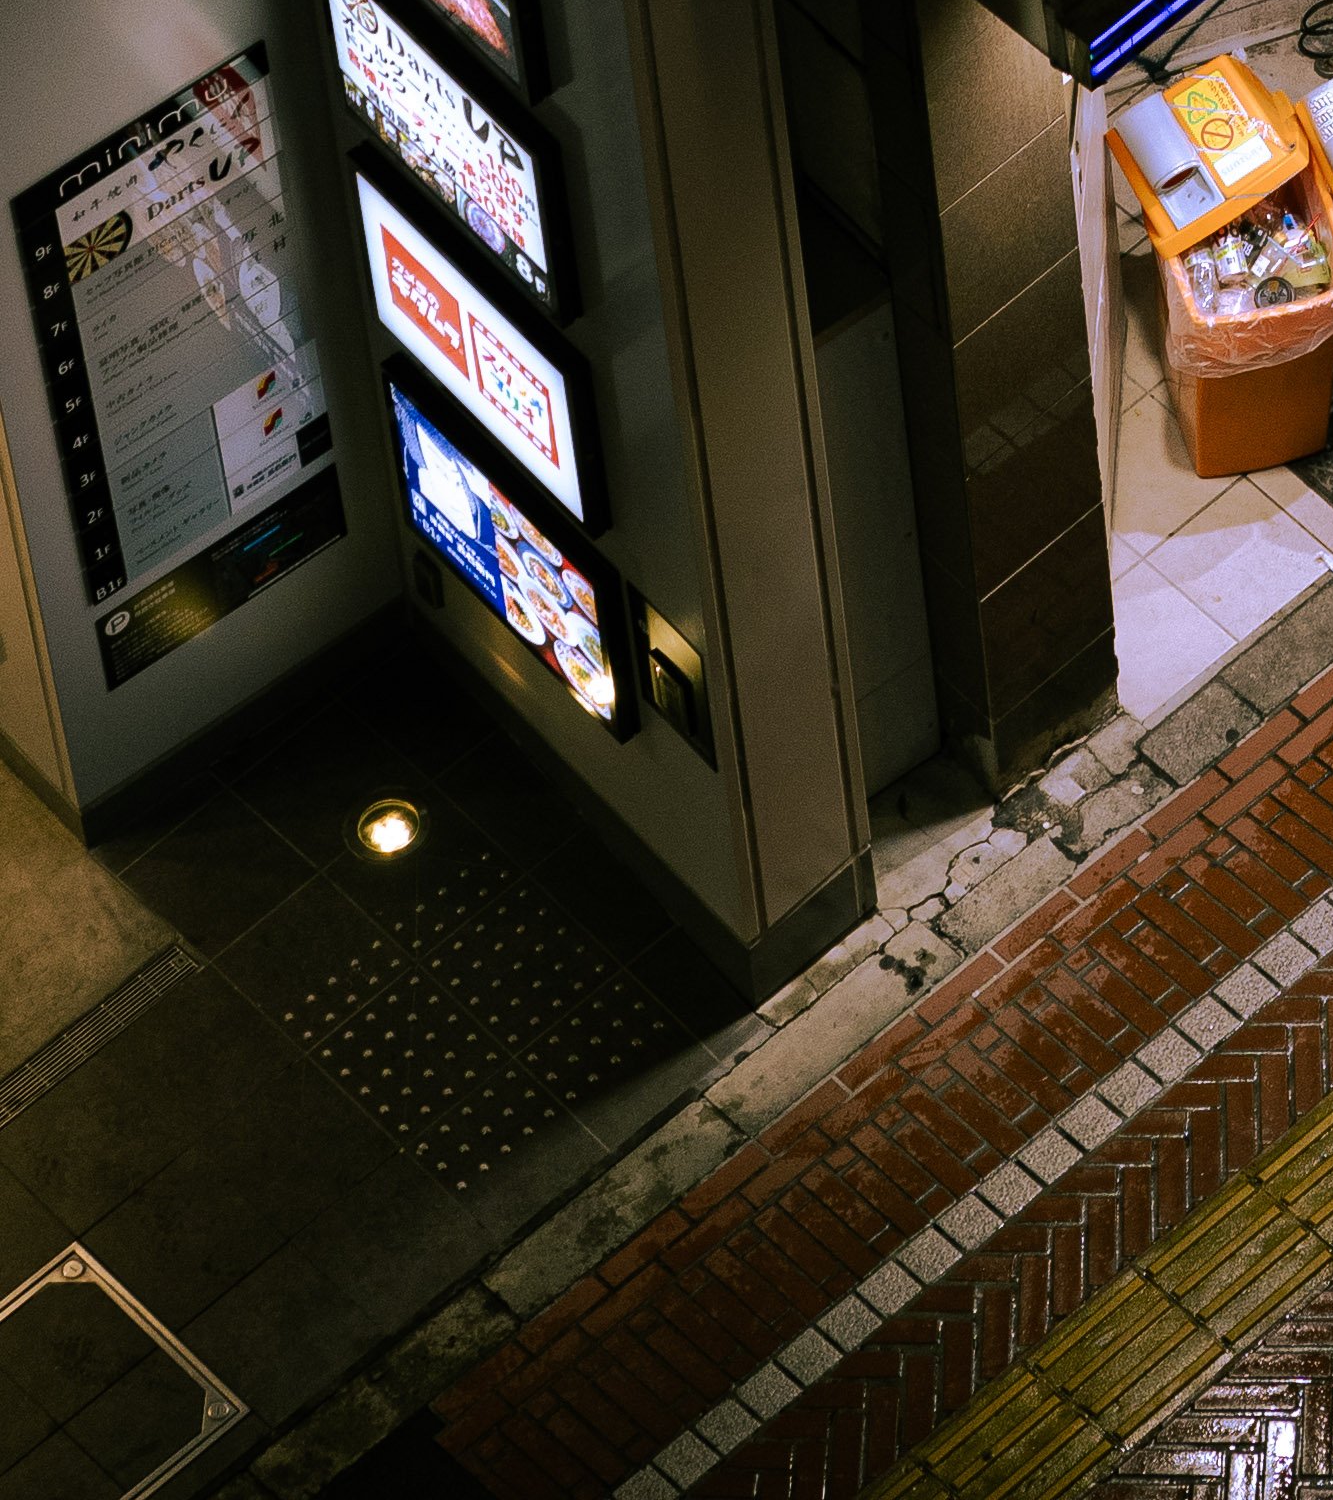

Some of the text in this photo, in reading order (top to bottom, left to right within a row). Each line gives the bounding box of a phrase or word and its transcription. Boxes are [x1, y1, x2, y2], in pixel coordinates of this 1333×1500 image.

[343, 25, 408, 102] ドリンク
[383, 22, 528, 189] Darts UP
[55, 76, 229, 199] minimu
[43, 281, 61, 299] 8F
[142, 169, 204, 223] Darts
[204, 130, 260, 186] UP
[35, 243, 53, 262] 9F
[389, 248, 441, 316] カメラの
[515, 253, 547, 294] 8F
[388, 261, 465, 359] キタムラ
[50, 319, 69, 337] 7F
[58, 357, 76, 376] 6F
[65, 395, 83, 413] 5F
[72, 432, 90, 451] 4F
[80, 471, 97, 488] 3F
[87, 507, 104, 525] 2F
[94, 543, 111, 561] 1F
[95, 577, 125, 602] B1F
